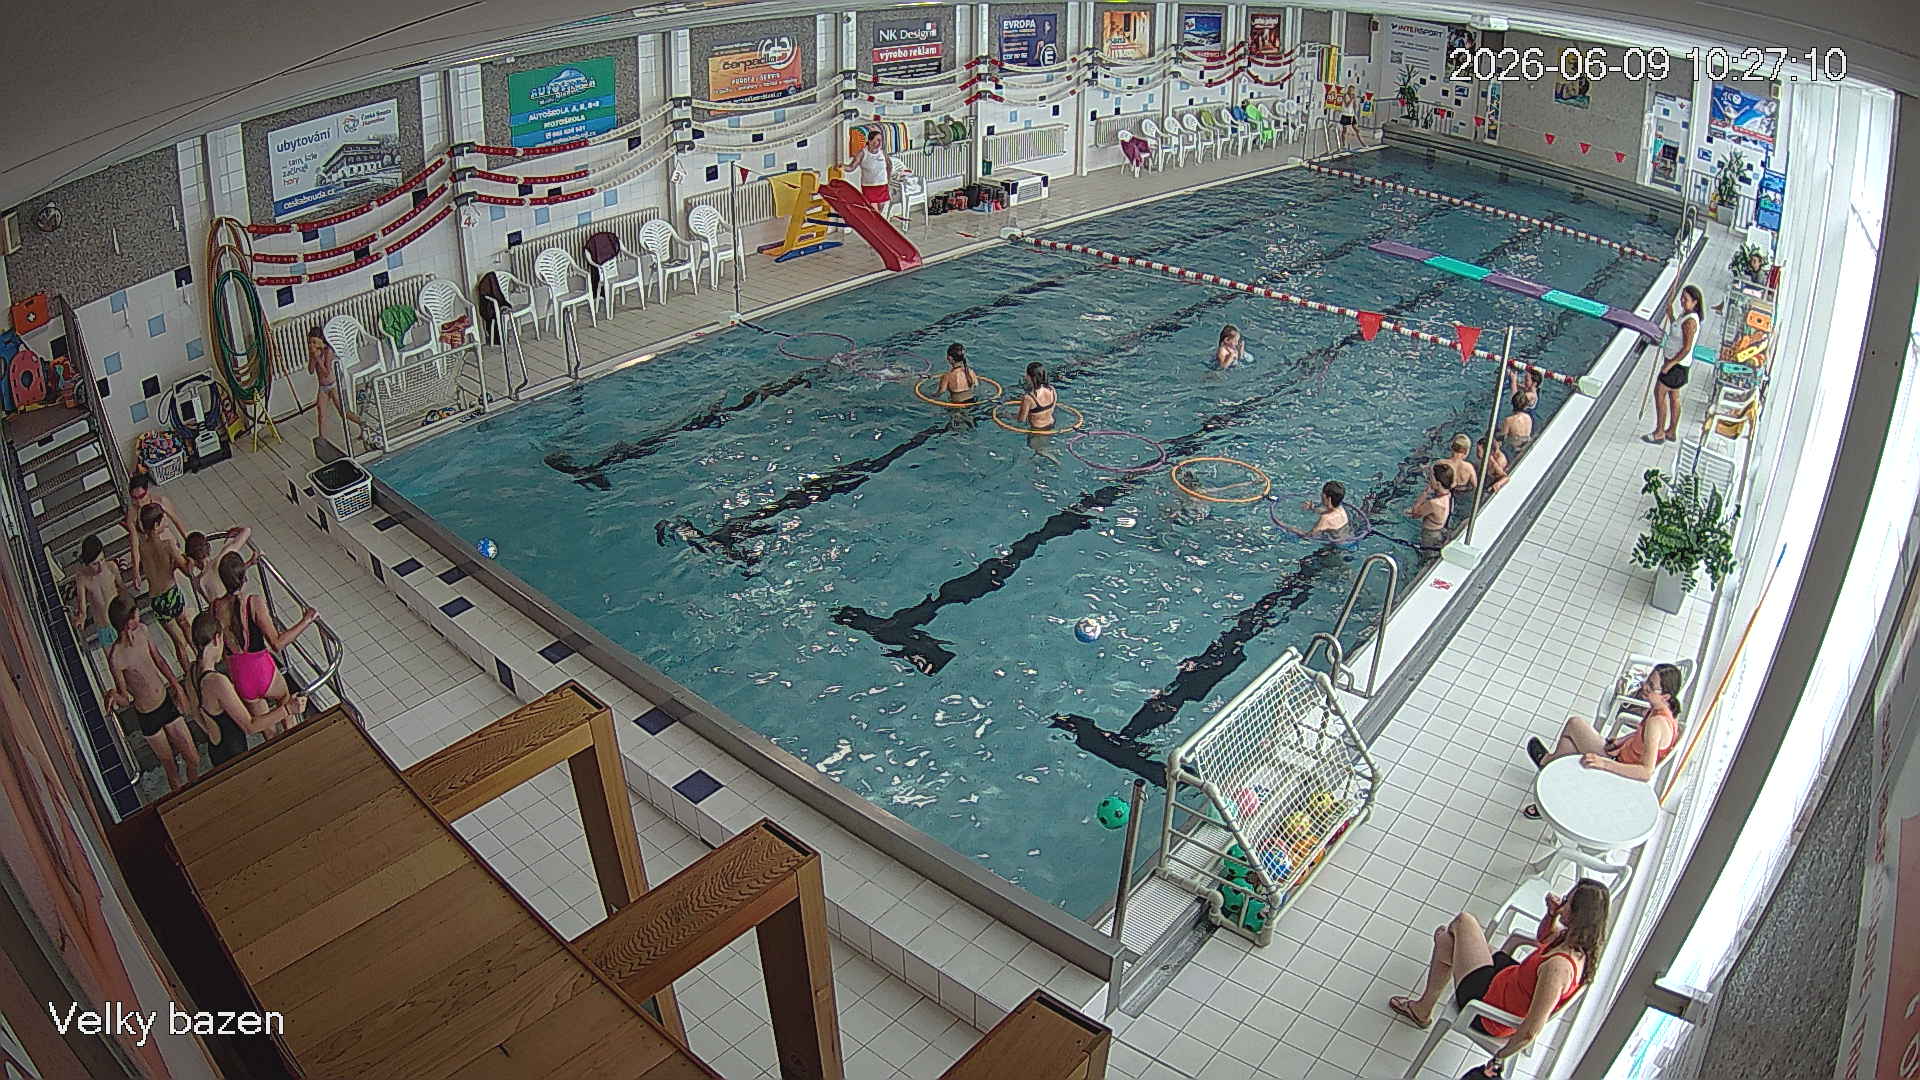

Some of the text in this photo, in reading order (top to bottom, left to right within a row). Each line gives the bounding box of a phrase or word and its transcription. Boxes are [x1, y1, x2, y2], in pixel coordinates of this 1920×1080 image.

[1003, 19, 1036, 29] EVROPA
[1398, 24, 1443, 38] INTERSPORT
[879, 28, 937, 42] NK Design
[879, 46, 937, 62] výroba reklam
[276, 128, 332, 153] ubytování
[673, 172, 680, 181] 3
[464, 216, 472, 226] 4
